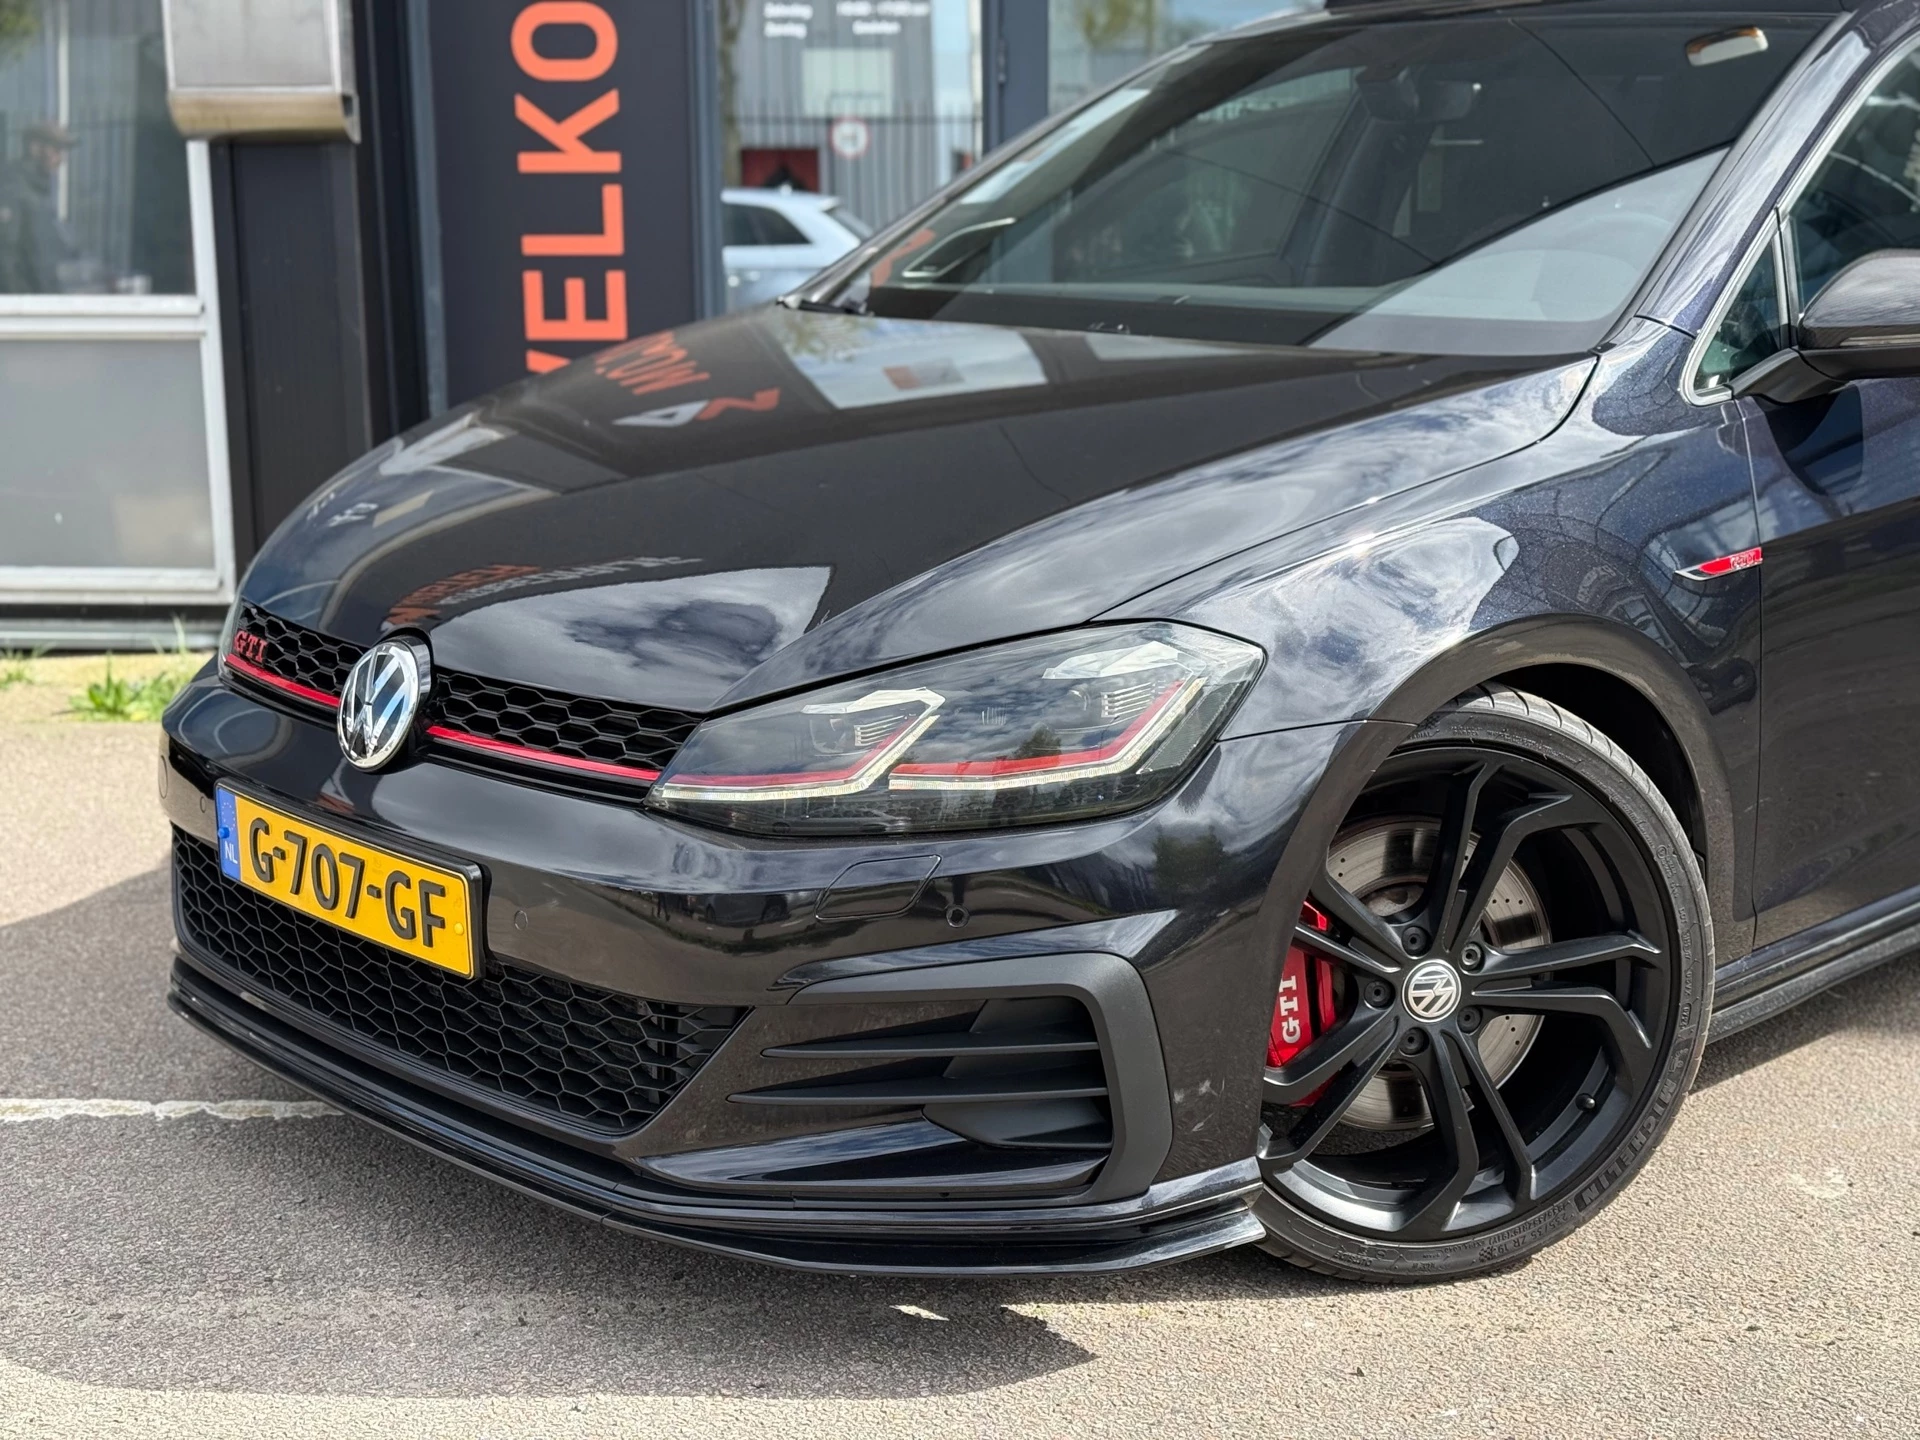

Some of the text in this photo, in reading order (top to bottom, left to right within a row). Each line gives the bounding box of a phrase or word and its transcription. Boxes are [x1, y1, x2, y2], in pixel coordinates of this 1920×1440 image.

[511, 1, 627, 373] ELKO
[233, 630, 267, 663] GTI
[224, 840, 238, 864] NL
[250, 817, 446, 948] G-707-GF
[1278, 975, 1300, 1044] GTI
[1581, 1079, 1678, 1206] MICHELIN
